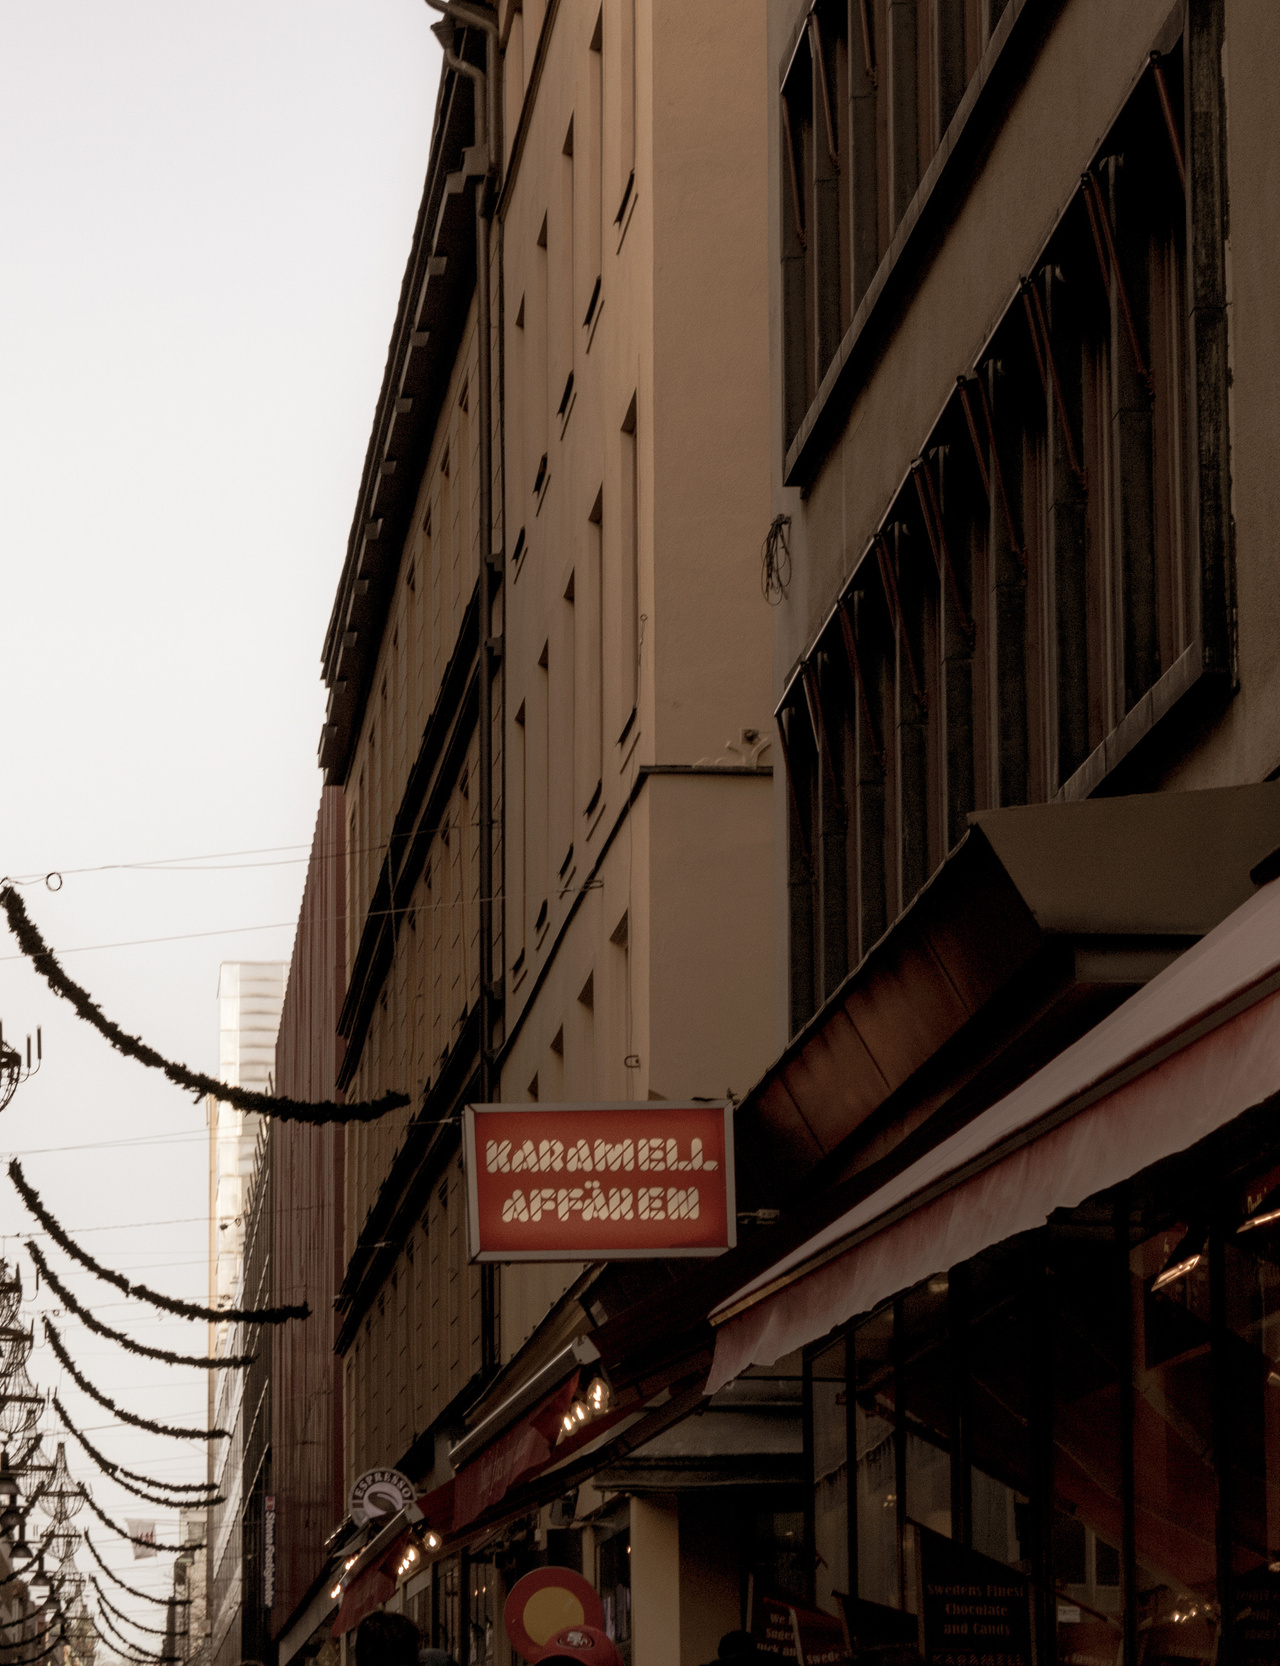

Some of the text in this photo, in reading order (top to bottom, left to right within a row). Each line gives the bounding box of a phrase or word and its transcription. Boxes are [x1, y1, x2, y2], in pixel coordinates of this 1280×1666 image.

[486, 1137, 718, 1173] KARAMELL
[502, 1180, 700, 1223] AFFÄREN
[354, 1471, 412, 1498] ESPRESSO
[944, 1602, 1009, 1617] Chocolate
[943, 1622, 1012, 1637] and Candy
